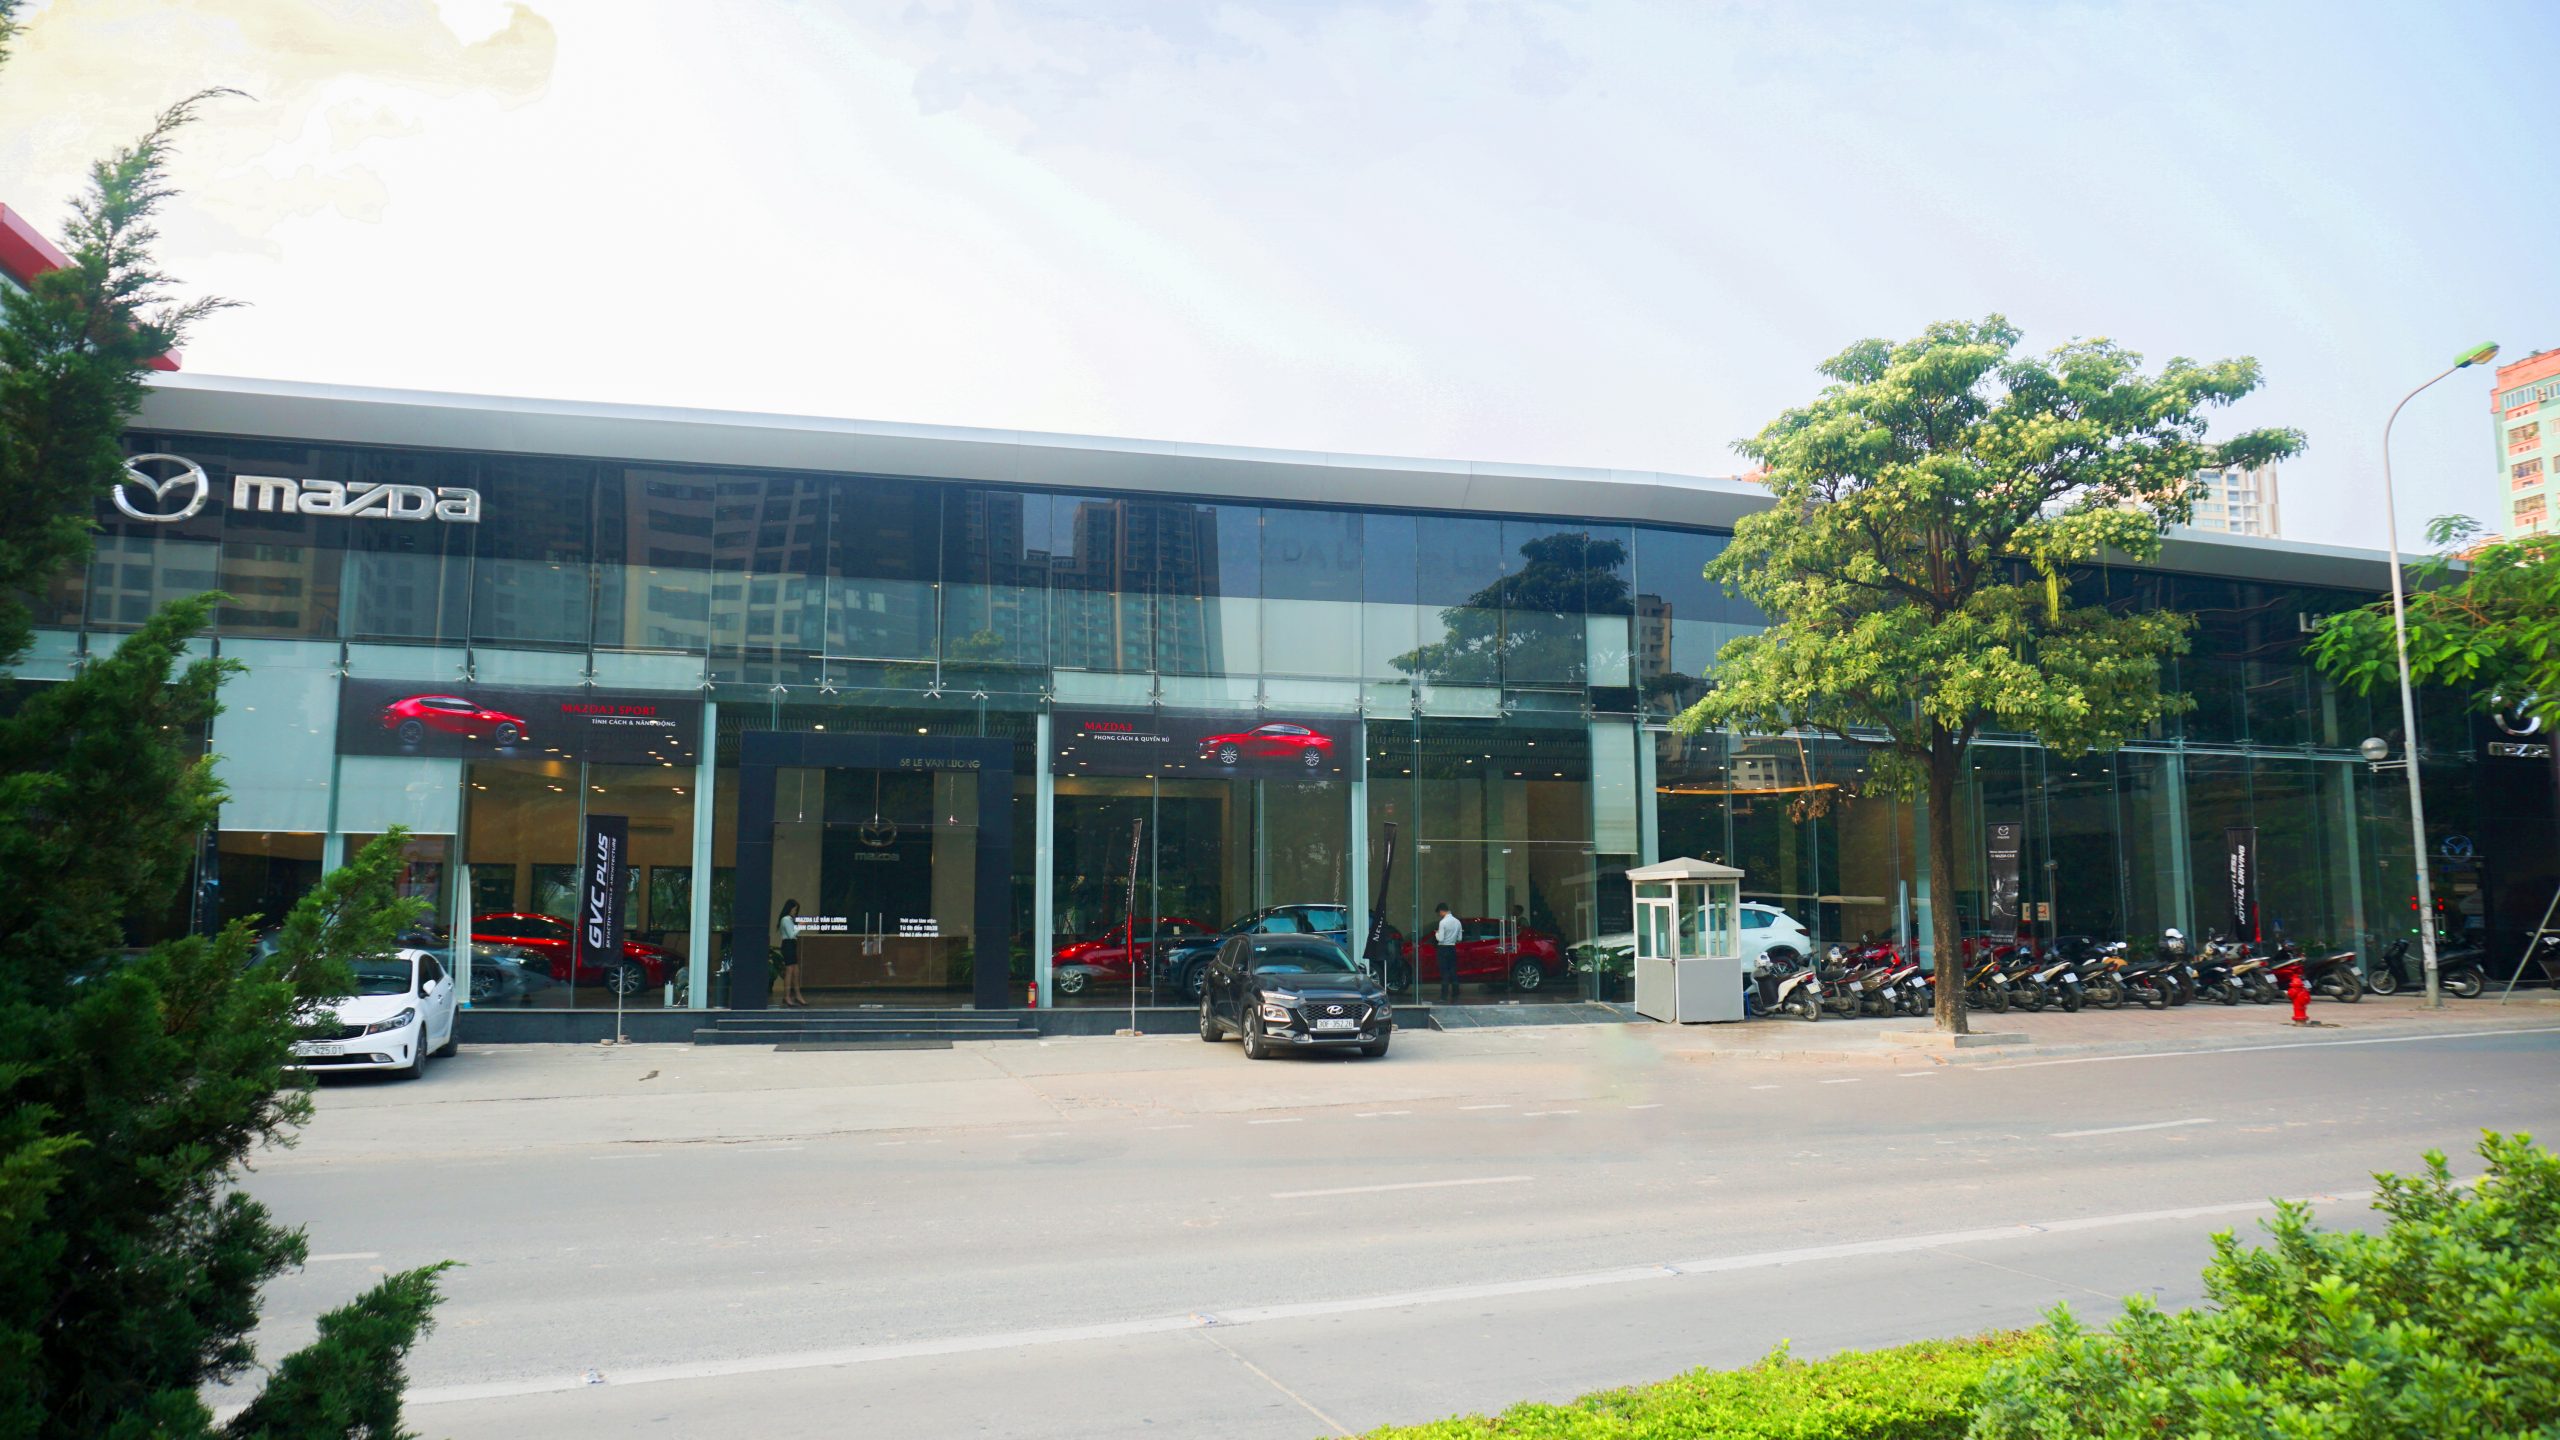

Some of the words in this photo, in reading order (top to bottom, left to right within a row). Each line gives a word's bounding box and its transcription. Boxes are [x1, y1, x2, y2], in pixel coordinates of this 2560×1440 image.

[233, 475, 481, 523] mazda
[561, 704, 615, 715] MAZDA3
[618, 706, 656, 716] SPORT
[1084, 721, 1133, 732] MAZDA3
[1094, 734, 1115, 742] PHONG
[596, 832, 608, 886] PLUS
[2237, 844, 2246, 886] DRIVING
[588, 885, 605, 949] GVC
[2238, 887, 2246, 925] JOYFUL
